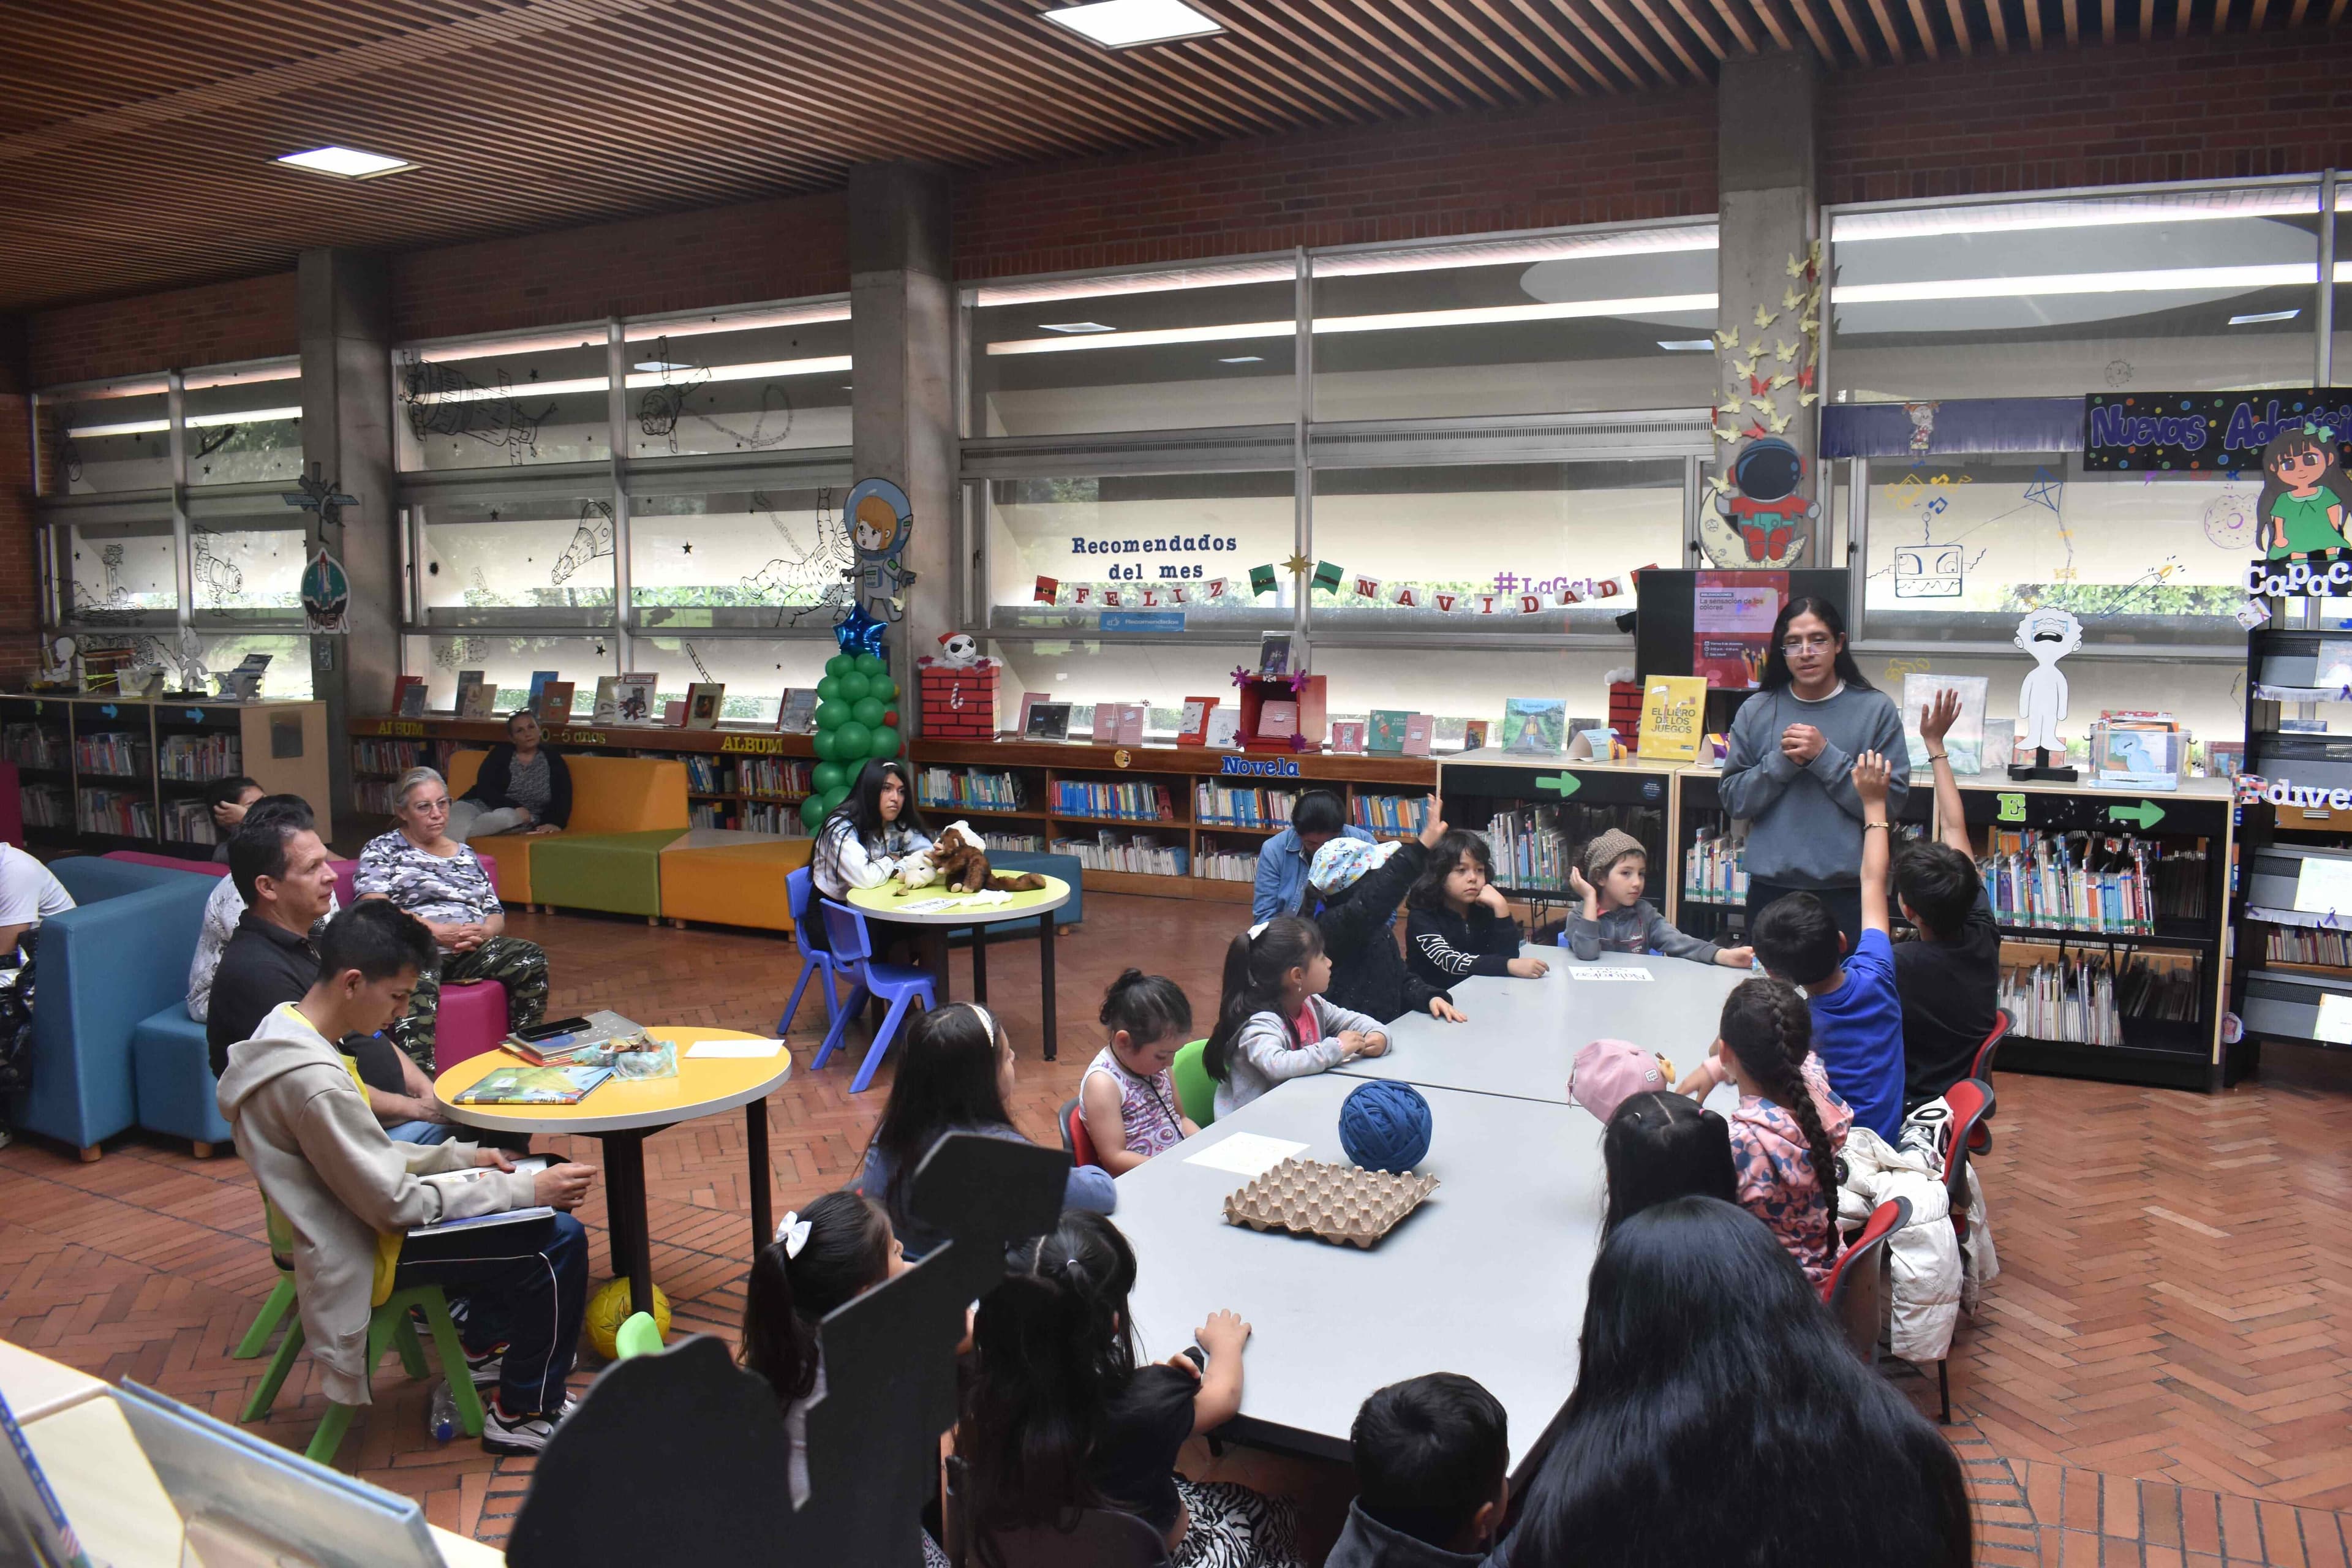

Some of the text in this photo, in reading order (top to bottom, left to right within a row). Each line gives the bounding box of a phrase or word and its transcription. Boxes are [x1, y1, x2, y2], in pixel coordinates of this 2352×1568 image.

[2090, 404, 2207, 451] Nuevas
[1072, 534, 1237, 554] Recomendados
[1109, 564, 1203, 580] del mes
[2242, 561, 2352, 597] Capac
[306, 613, 347, 630] NASA
[562, 728, 571, 742] 5
[1651, 725, 1692, 733] JUEGOS
[721, 736, 783, 754] ALBUM
[1221, 755, 1300, 777] Novela
[2267, 778, 2352, 811] dive
[1997, 793, 2026, 822] E
[1416, 933, 1480, 975] NIKE
